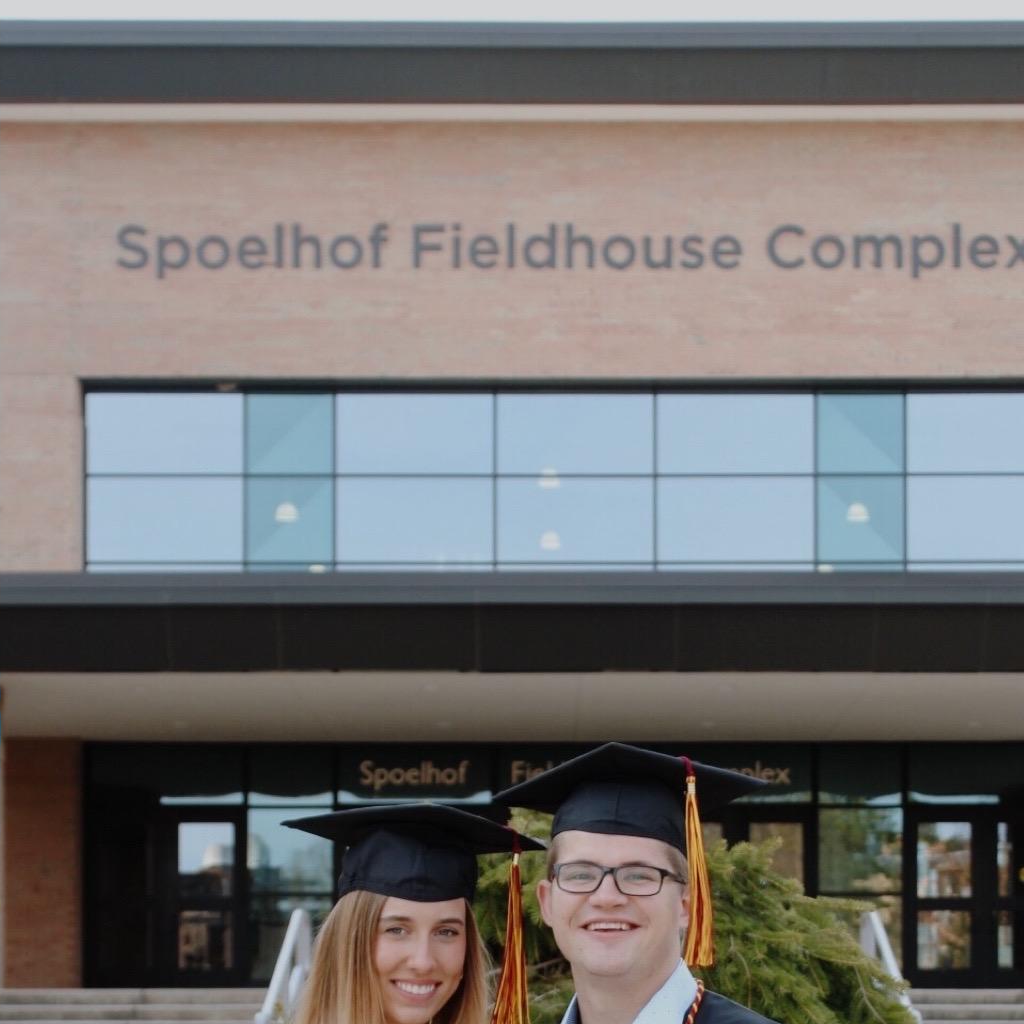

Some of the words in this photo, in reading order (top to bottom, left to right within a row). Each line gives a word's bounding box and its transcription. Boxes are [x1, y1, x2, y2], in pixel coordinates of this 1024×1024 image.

[116, 223, 389, 279] Spoelhof
[412, 222, 743, 270] Fieldhouse
[360, 759, 470, 791] Spoelhof
